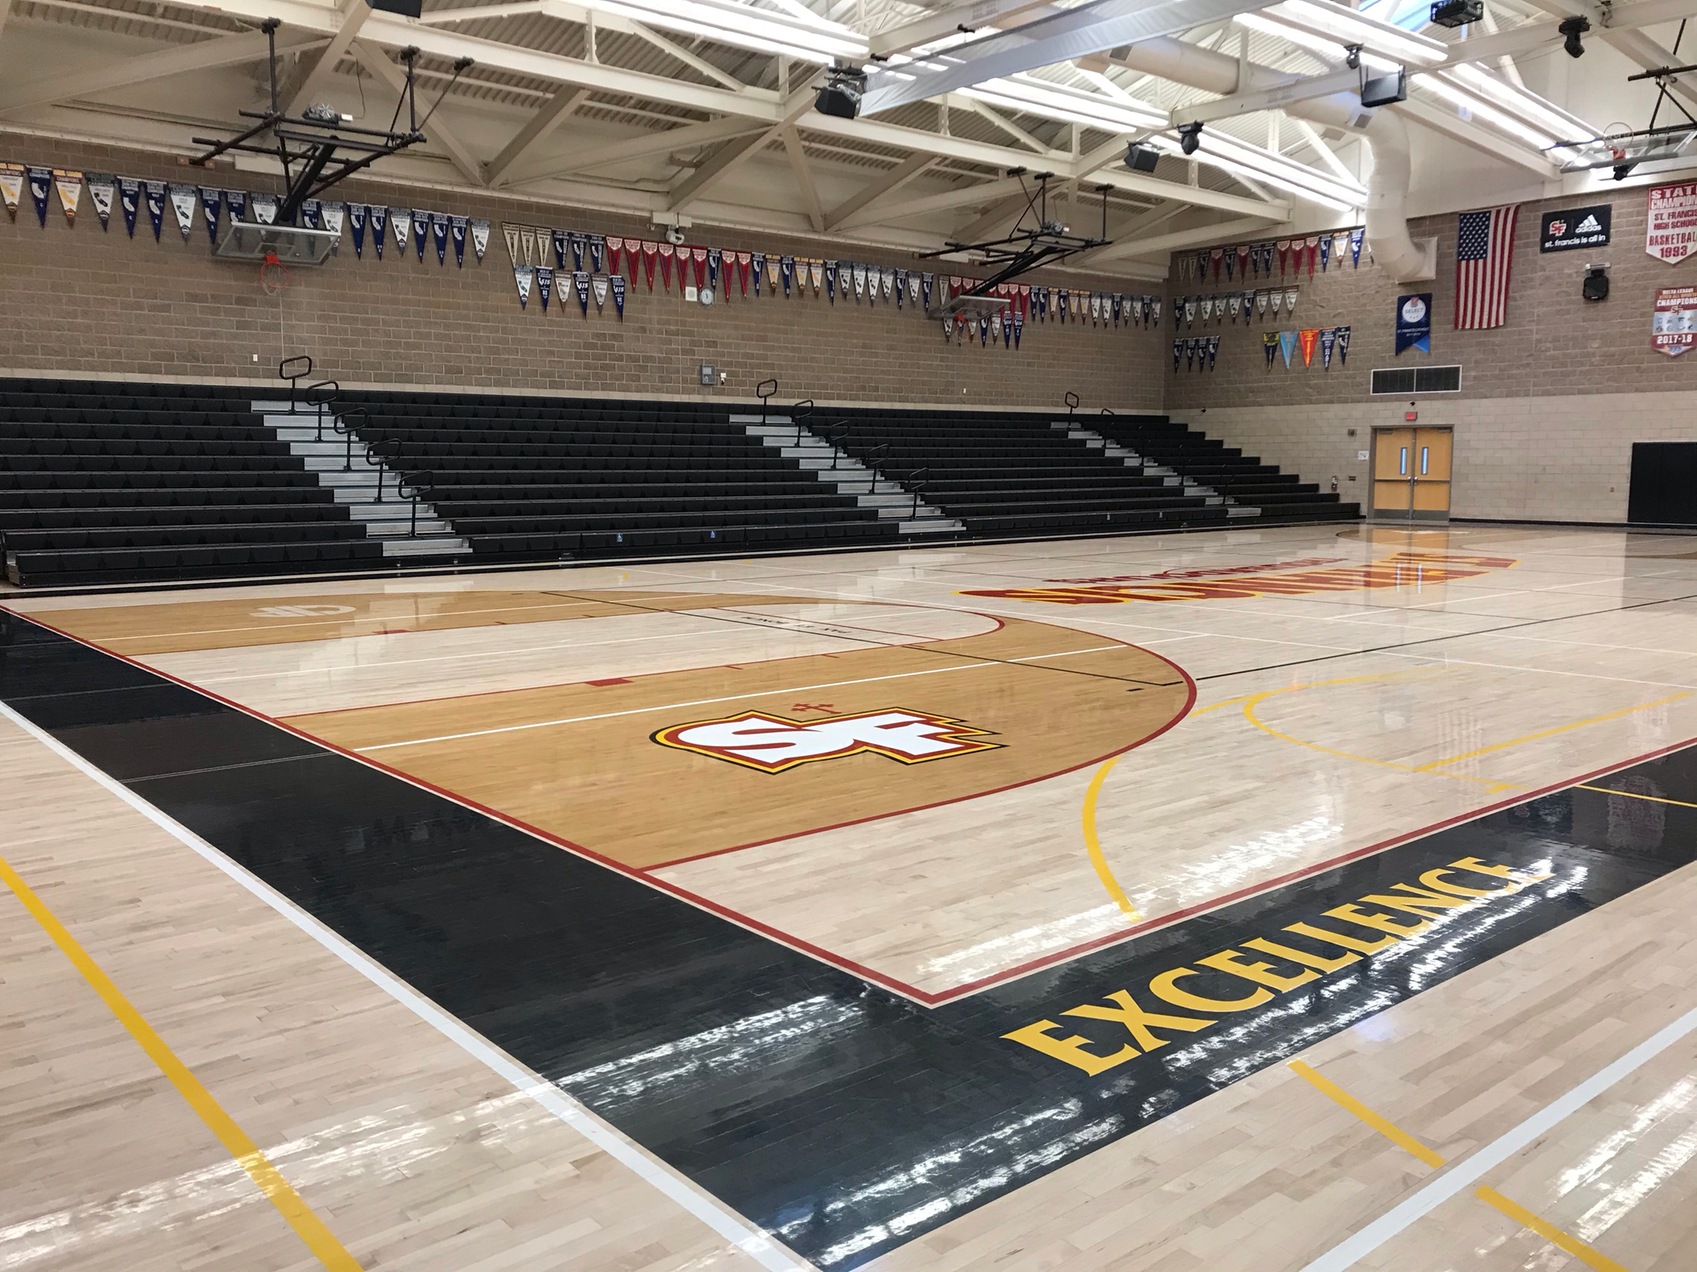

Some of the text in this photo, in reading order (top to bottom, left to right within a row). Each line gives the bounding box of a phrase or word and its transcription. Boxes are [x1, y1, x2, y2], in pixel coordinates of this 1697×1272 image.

[1651, 185, 1697, 200] STAT
[1549, 220, 1567, 237] SF
[1575, 224, 1602, 233] adidas
[1544, 240, 1554, 248] st.
[1554, 237, 1580, 246] francis
[1580, 236, 1588, 244] is
[1659, 245, 1688, 258] 1993
[1656, 334, 1693, 344] 2017-18
[662, 711, 988, 768] SF
[1000, 856, 1557, 1077] EXCELLENCE
